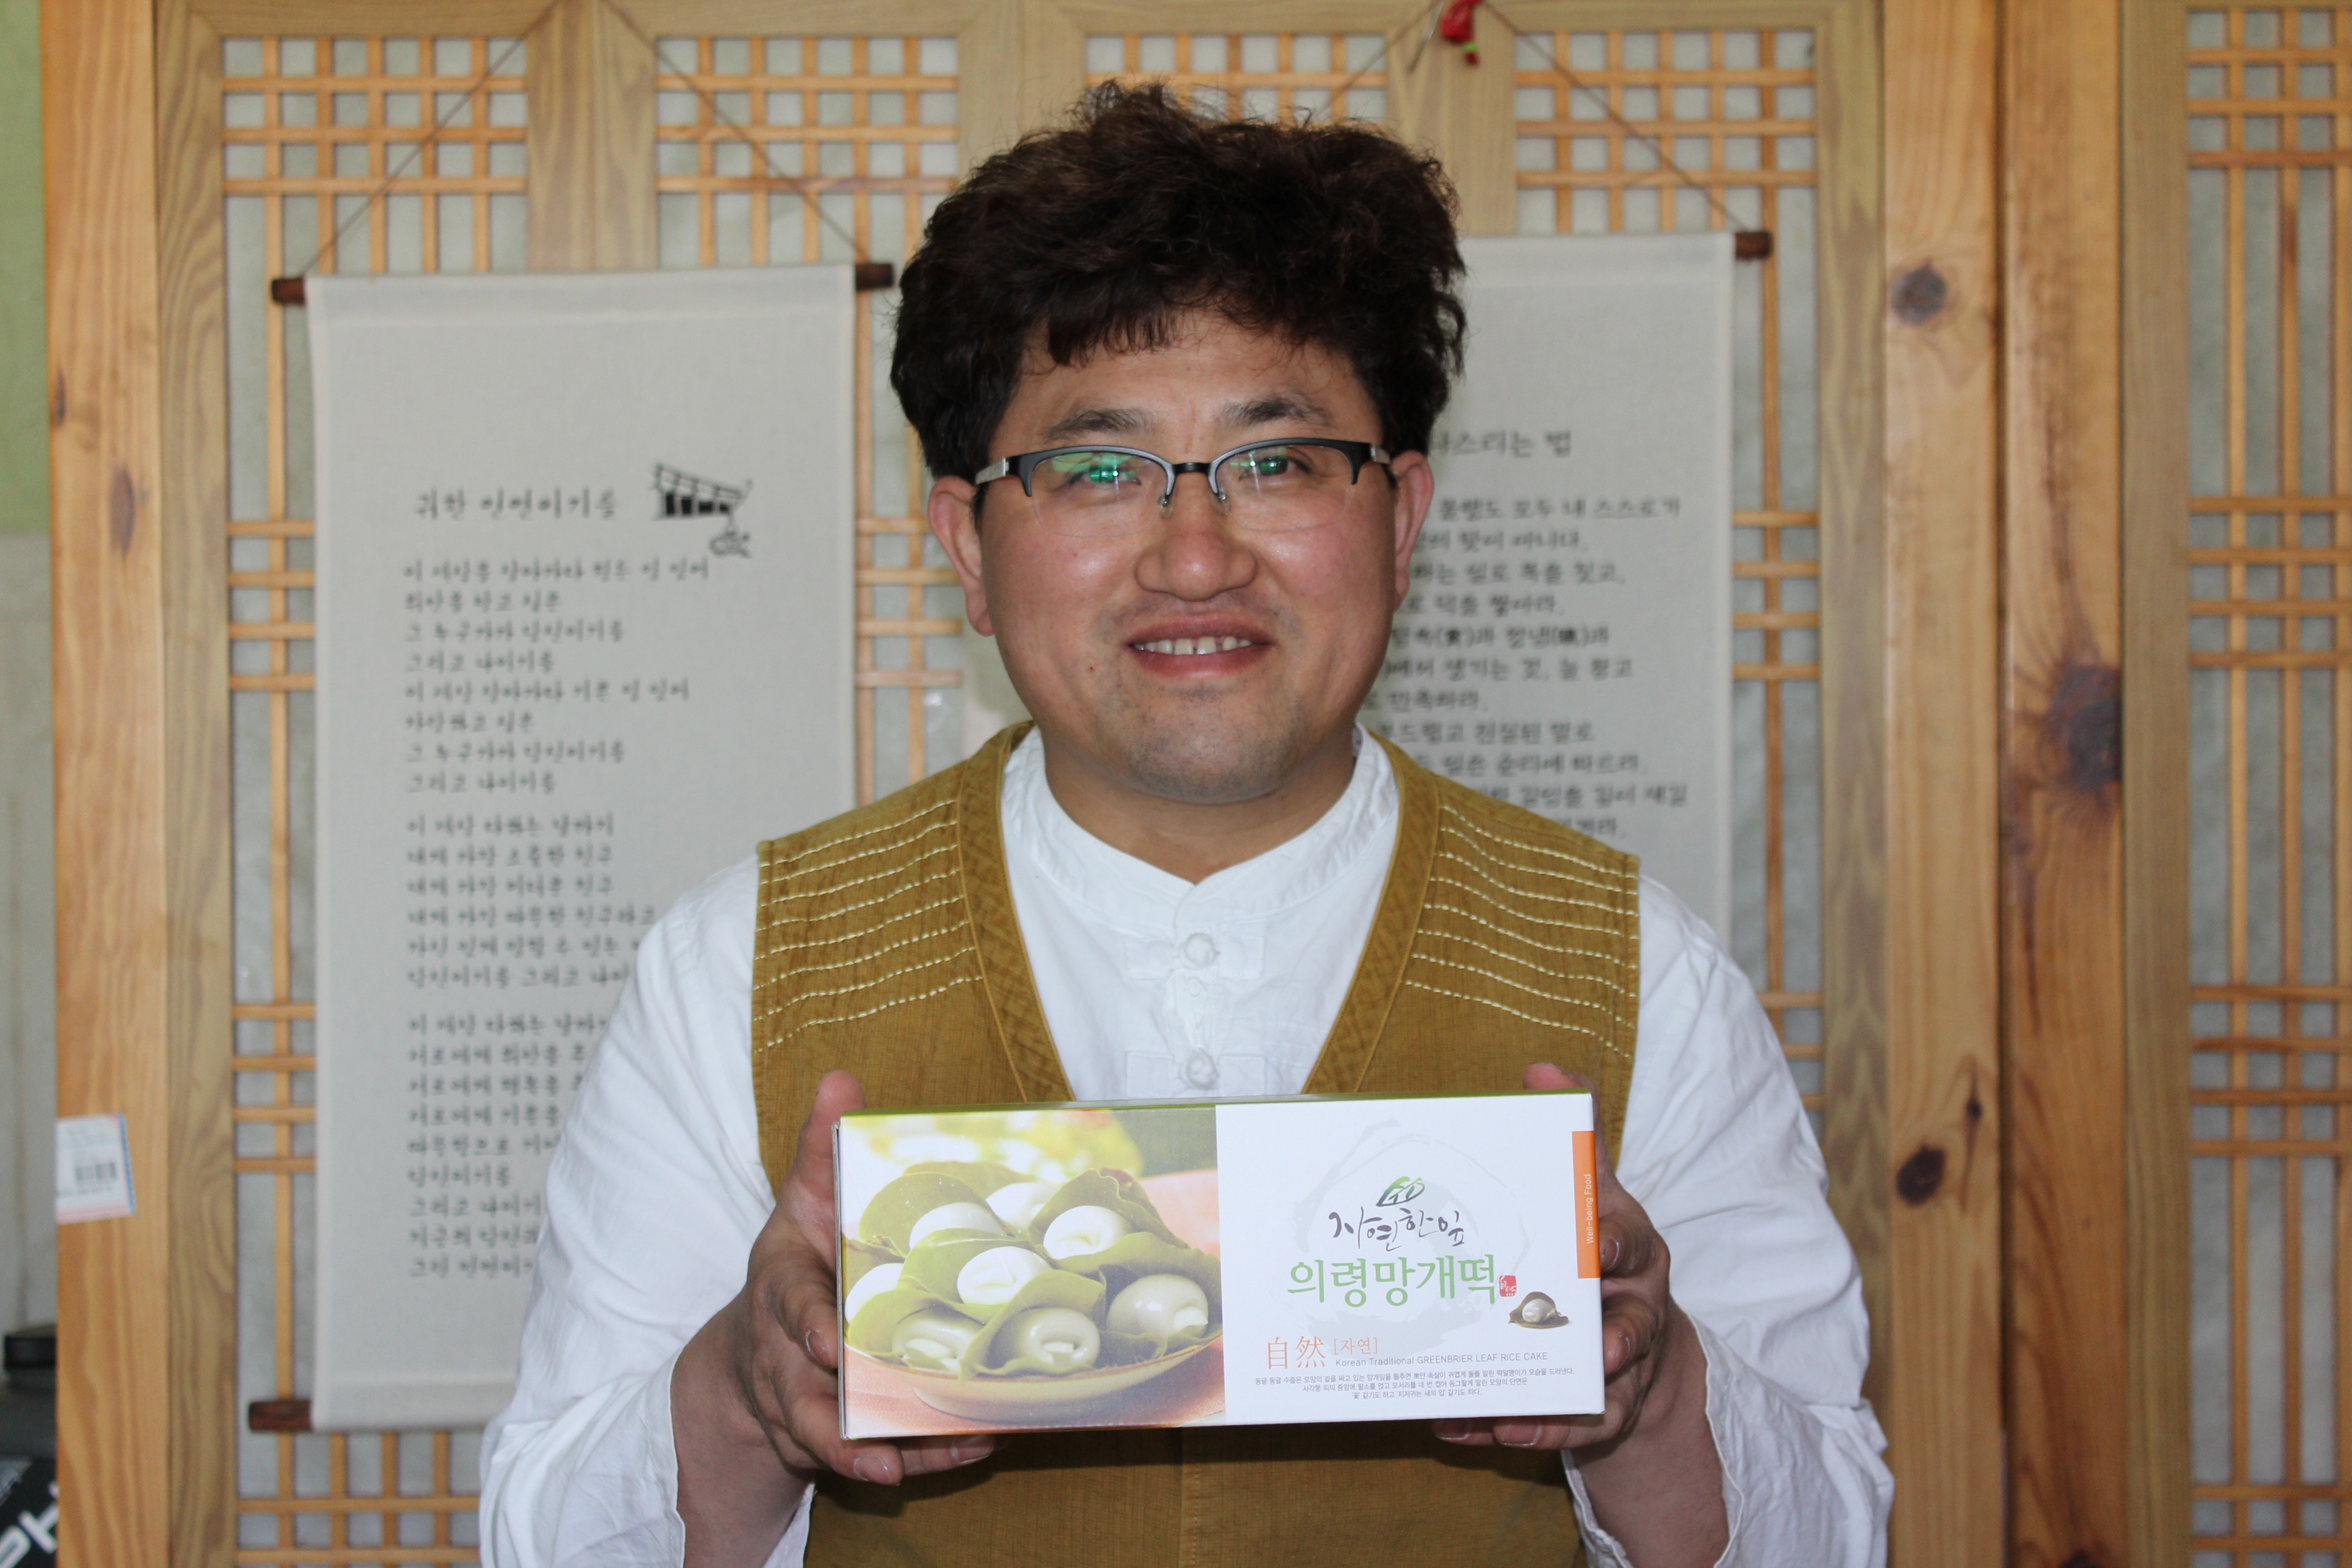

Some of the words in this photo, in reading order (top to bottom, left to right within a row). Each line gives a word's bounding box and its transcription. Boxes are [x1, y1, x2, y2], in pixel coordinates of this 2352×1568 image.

[1584, 1174, 1592, 1194] Food
[1328, 1207, 1465, 1252] 자연한잎
[1585, 1197, 1595, 1244] Well-being
[1288, 1254, 1496, 1307] 의령망개떡
[1267, 1336, 1326, 1369] 自然
[1334, 1337, 1378, 1355] [자연]
[1336, 1358, 1366, 1367] Korean
[1369, 1356, 1414, 1365] Traditional
[1417, 1355, 1473, 1364] GREENBRIER
[1475, 1354, 1498, 1362] LEAF
[1501, 1353, 1521, 1361] RICE
[1524, 1352, 1548, 1360] CAKE
[1284, 1376, 1302, 1384] 수줍은
[1304, 1375, 1322, 1384] 모양의
[1338, 1375, 1351, 1383] 싸고
[1352, 1374, 1365, 1382] 있는
[1428, 1371, 1446, 1379] 속살이
[1448, 1371, 1466, 1379] 귀엽게
[1529, 1368, 1546, 1376] 모습을
[1549, 1367, 1575, 1375] 드러낸다.
[1303, 1384, 1321, 1392] 사각형
[1323, 1384, 1335, 1392] 피의
[1337, 1383, 1355, 1391] 중앙에
[1392, 1381, 1416, 1389] 모서리를
[1426, 1380, 1433, 1388] 번
[1449, 1379, 1473, 1388] 동그랗게
[1509, 1377, 1529, 1385] 단면은
[1448, 1388, 1466, 1396] 같기도
